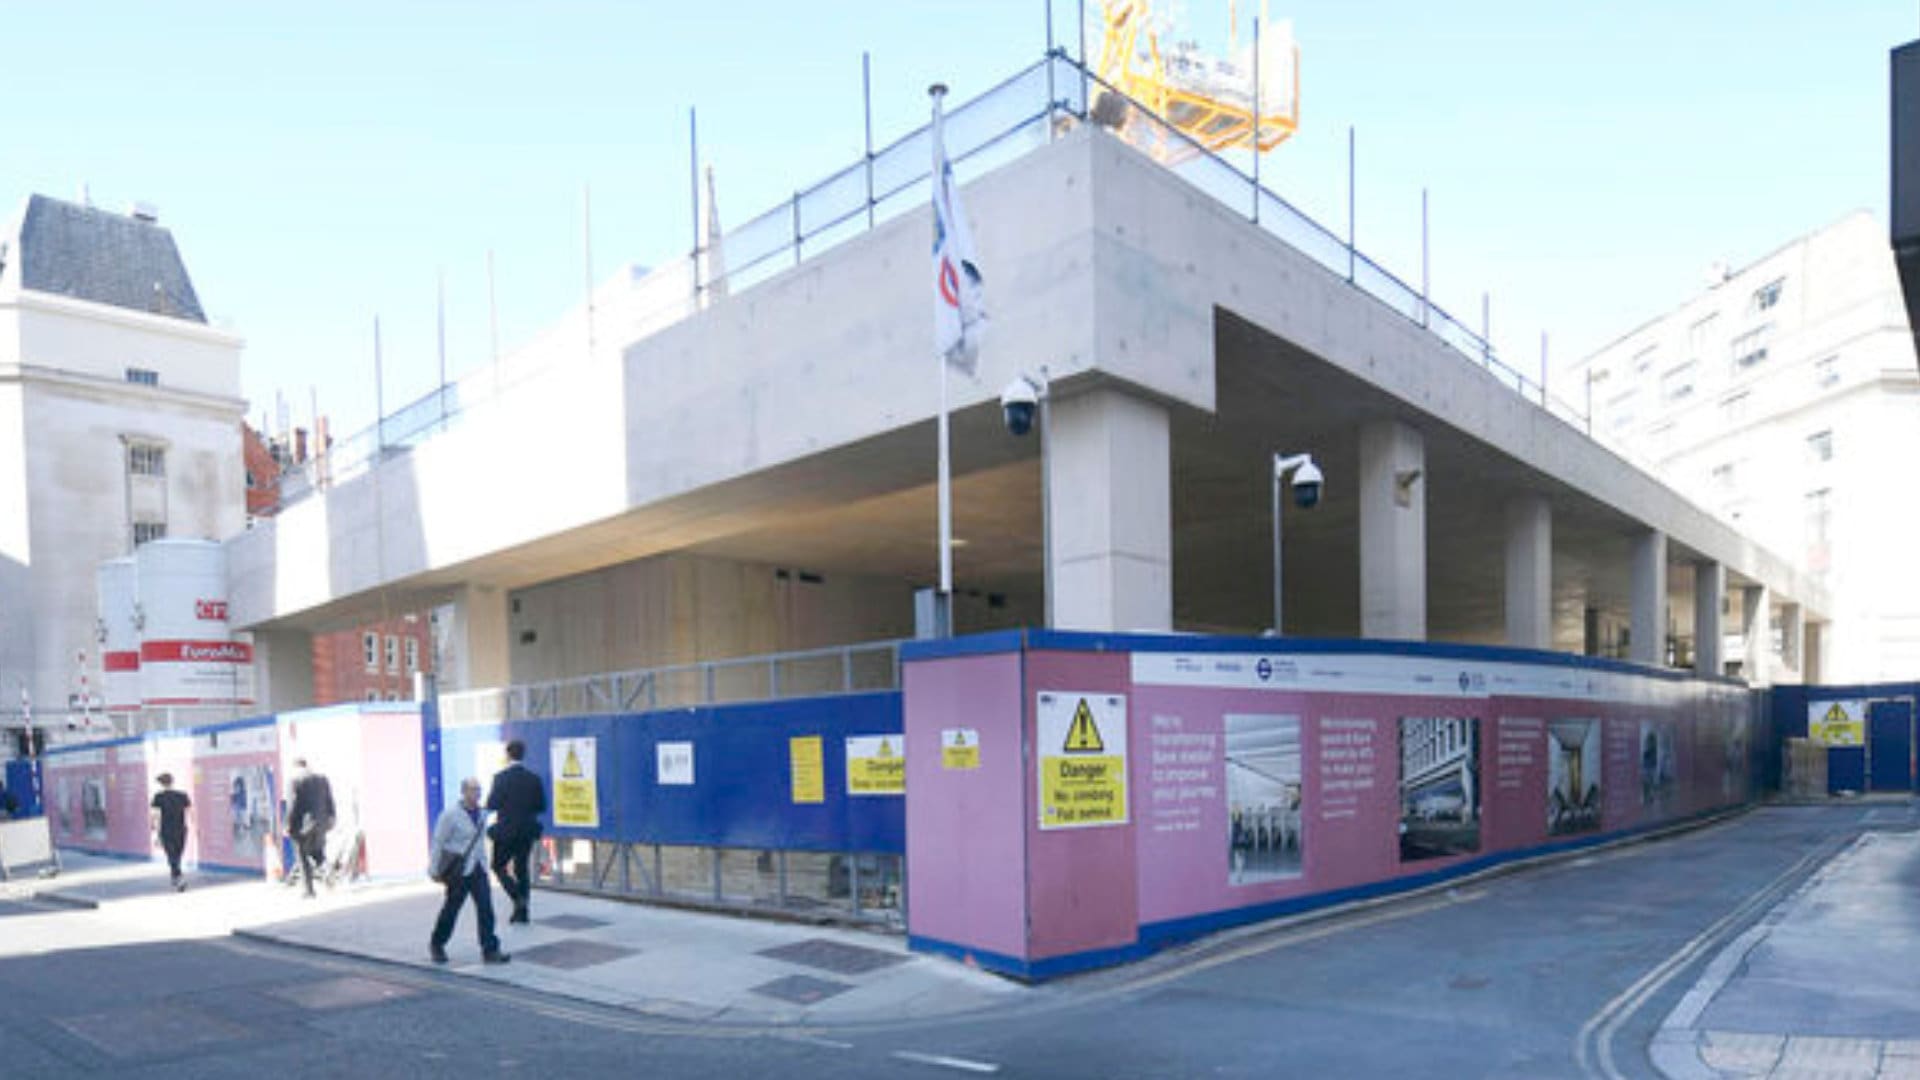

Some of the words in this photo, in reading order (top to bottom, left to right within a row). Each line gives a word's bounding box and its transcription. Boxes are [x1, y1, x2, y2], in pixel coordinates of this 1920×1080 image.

[1061, 761, 1107, 780] Danger
[1054, 790, 1069, 801] No
[1074, 789, 1114, 802] climbing
